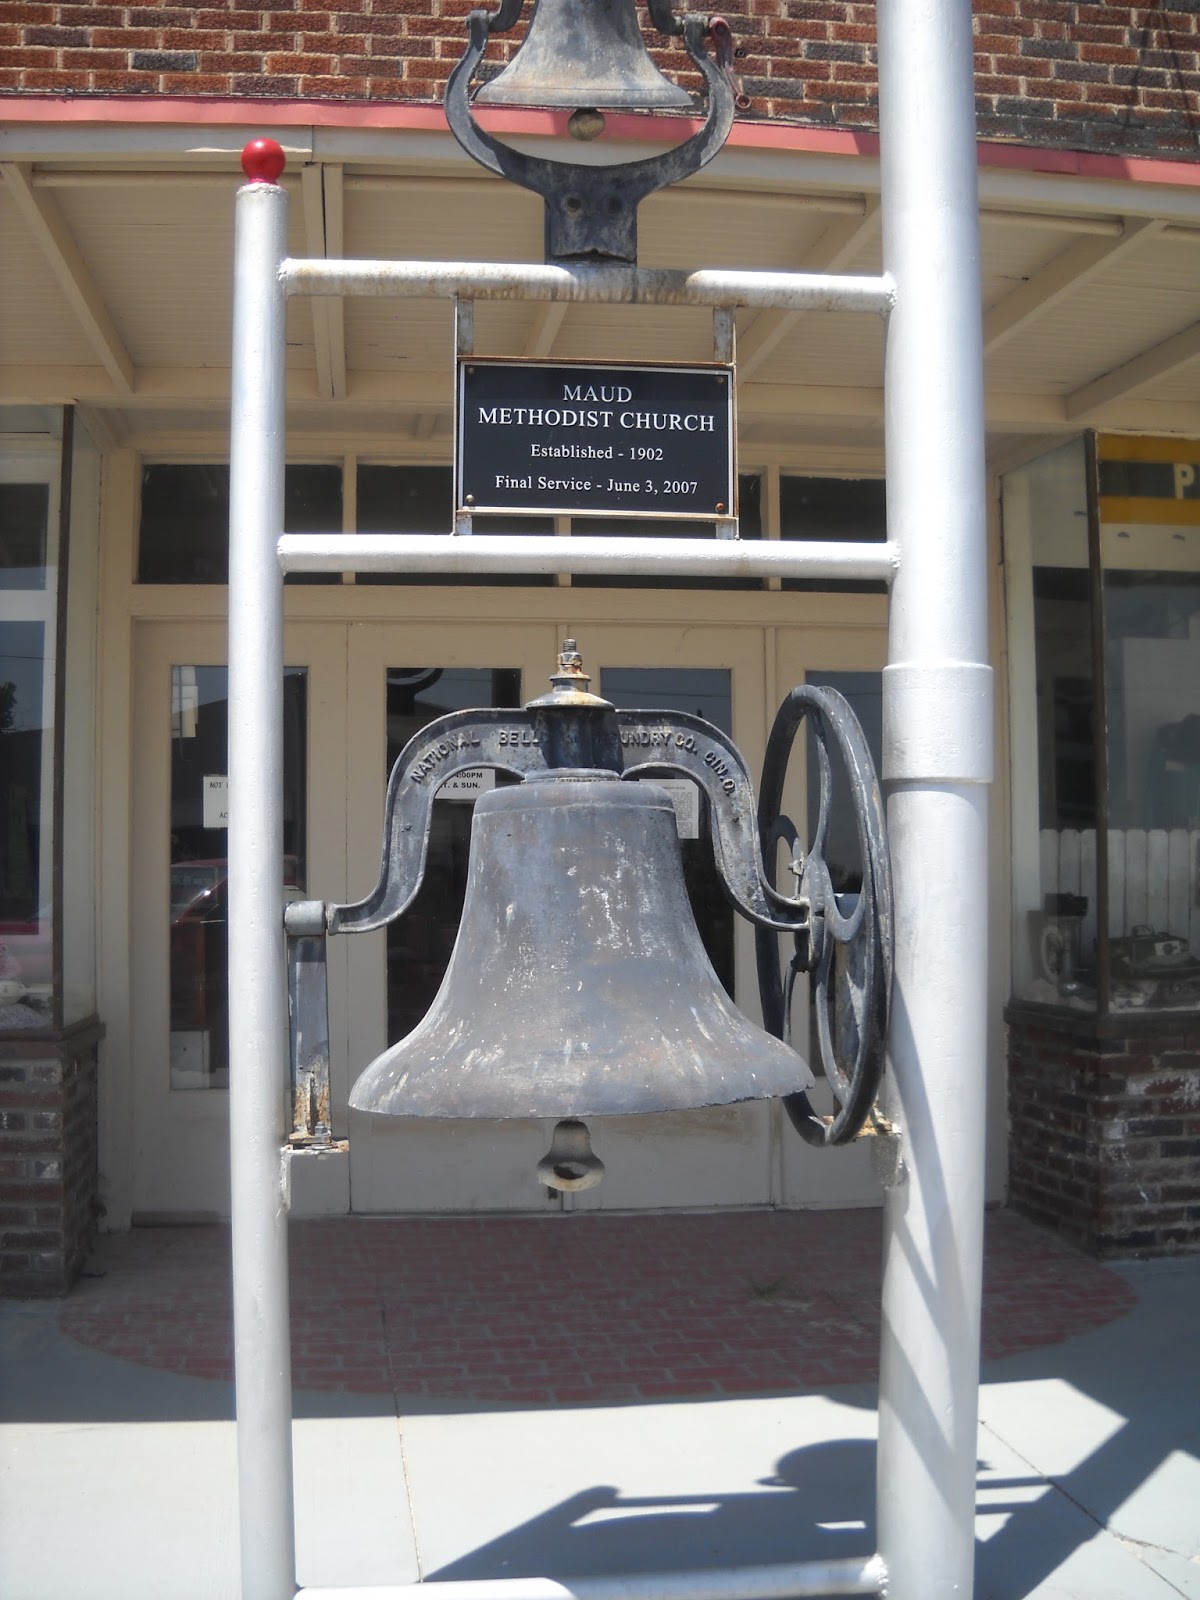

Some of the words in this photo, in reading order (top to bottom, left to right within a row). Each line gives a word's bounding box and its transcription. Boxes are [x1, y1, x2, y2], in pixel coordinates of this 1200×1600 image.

[563, 385, 632, 403] MAUD
[478, 407, 613, 428] METHODIST
[619, 412, 715, 431] CHURCH
[530, 444, 613, 460] Established
[630, 447, 663, 461] 1902
[495, 475, 532, 489] Final
[538, 477, 591, 491] Service
[607, 479, 640, 493] June
[645, 480, 658, 495] 3,
[663, 481, 698, 494] 2007
[410, 730, 481, 785] NATIONAL
[499, 730, 540, 747] BELL
[609, 731, 672, 748] UNDRY
[674, 733, 698, 756] CO.
